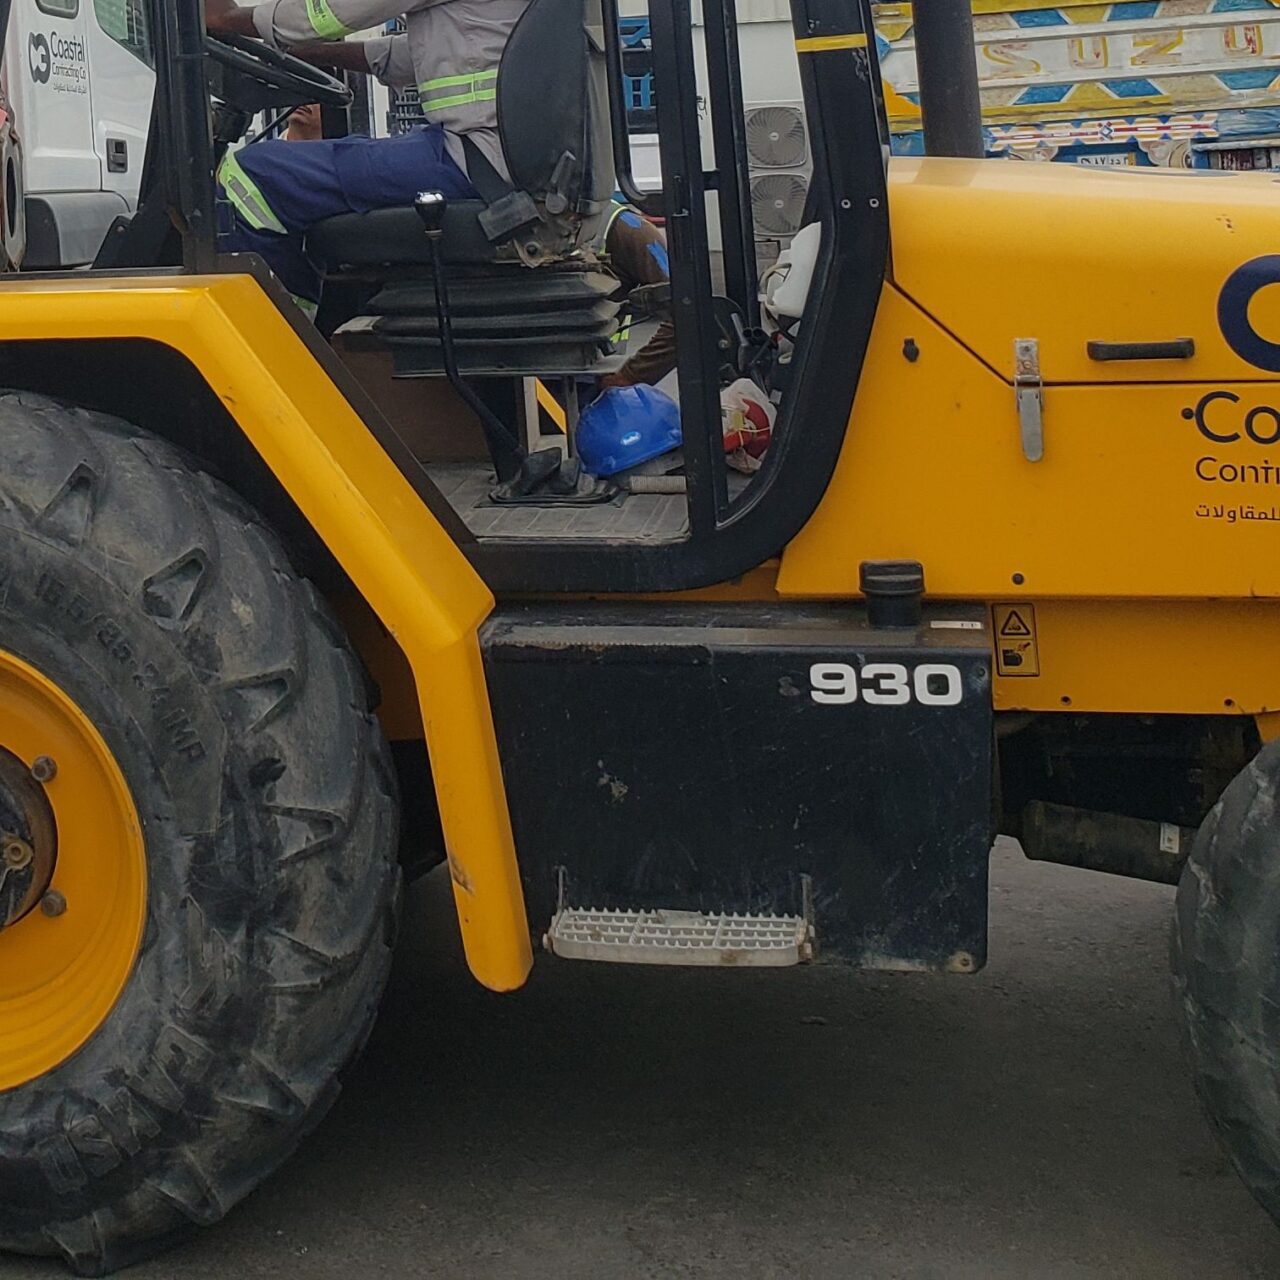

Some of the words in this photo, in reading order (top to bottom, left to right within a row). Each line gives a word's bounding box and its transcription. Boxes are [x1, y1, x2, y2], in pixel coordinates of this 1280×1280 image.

[50, 31, 86, 63] Coastal
[982, 24, 1263, 74] SUZU
[1195, 504, 1280, 523] لمقاولات
[810, 663, 963, 706] 930
